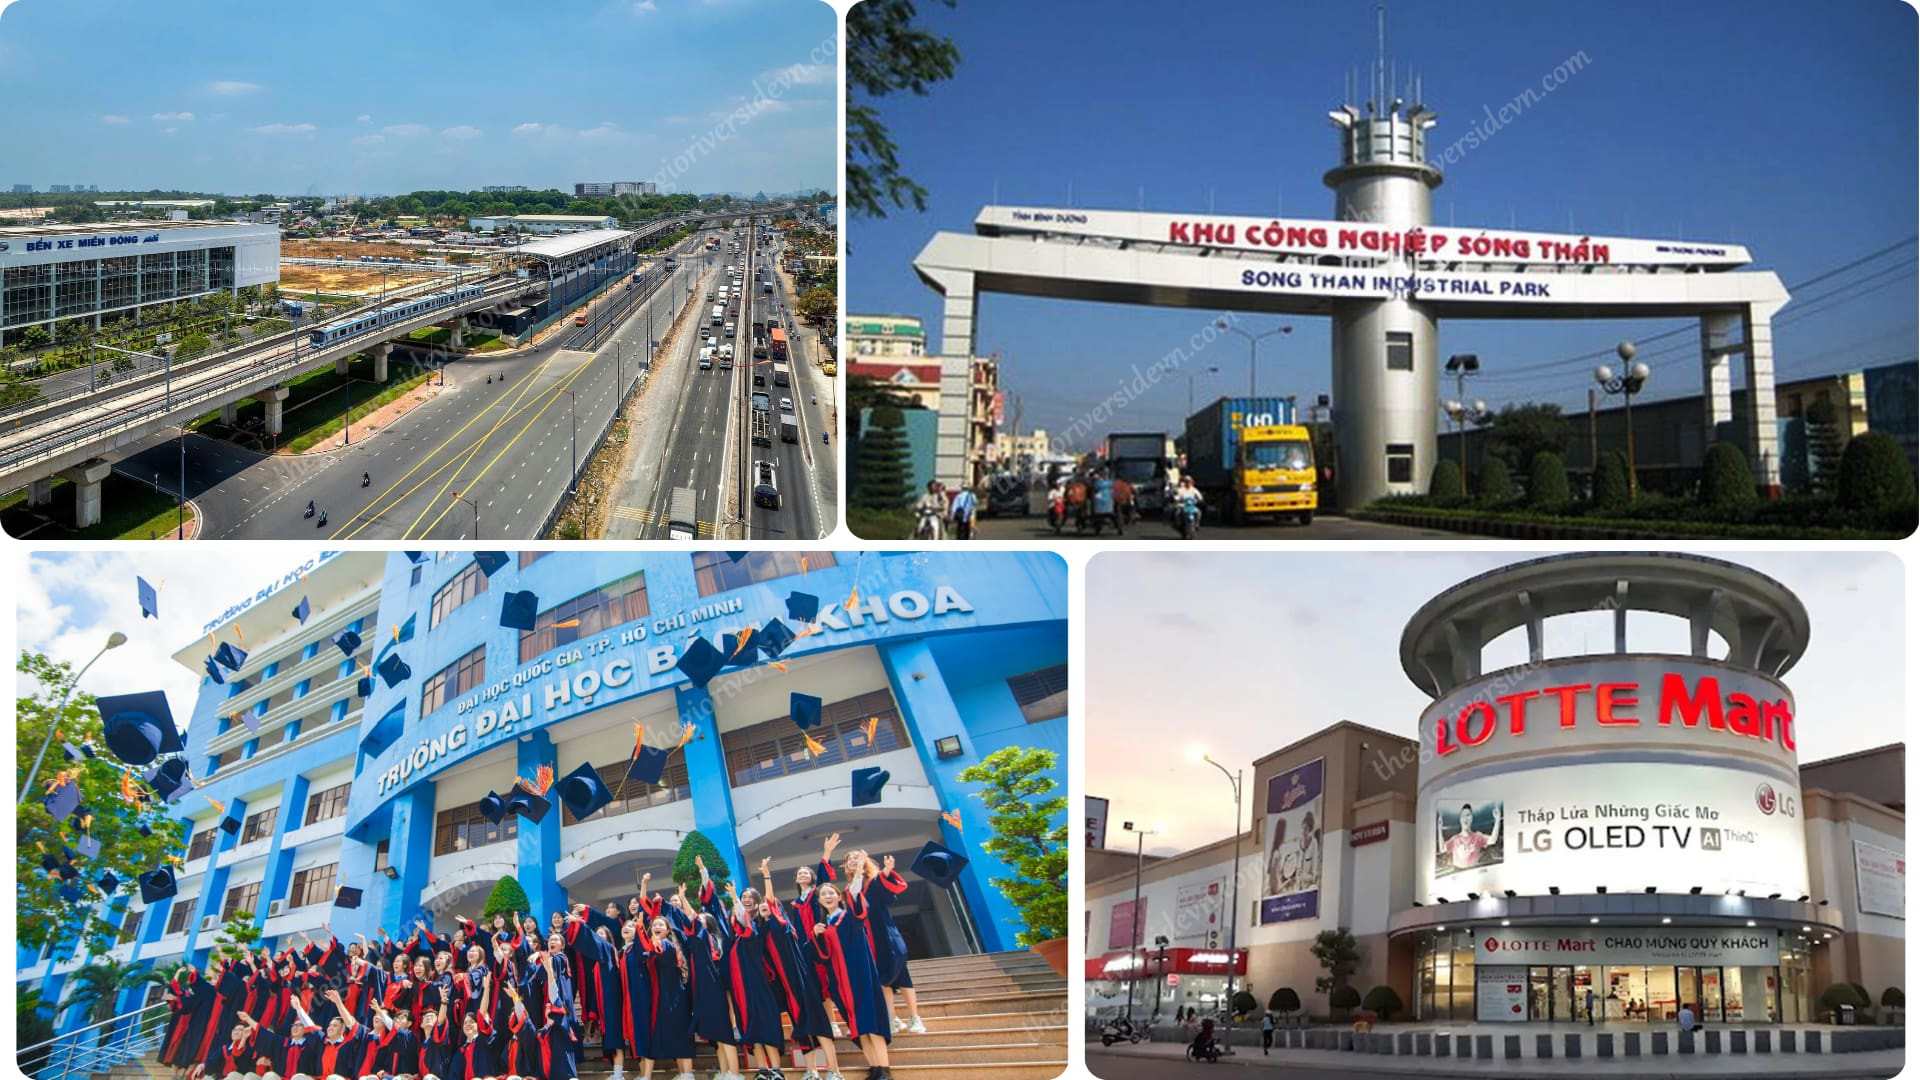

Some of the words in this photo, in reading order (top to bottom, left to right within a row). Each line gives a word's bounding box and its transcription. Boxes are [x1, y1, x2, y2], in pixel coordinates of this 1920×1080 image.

[26, 237, 52, 252] BẾN
[57, 239, 74, 250] XE
[109, 234, 139, 246] ĐÔNG
[1169, 220, 1235, 246] KHU
[1245, 220, 1328, 248] CÔNG
[1338, 227, 1448, 258] NGHIỆP
[1457, 231, 1531, 259] SÓNG
[1241, 269, 1302, 288] SONG
[1309, 272, 1366, 291] THAN
[1372, 276, 1494, 295] INDUSTRIAL
[1499, 280, 1551, 298] PARK
[457, 693, 480, 716] ĐẠI
[482, 679, 511, 703] HỌC
[512, 658, 553, 687] QUỐC
[556, 649, 584, 669] GIA
[587, 635, 616, 657] TP.
[621, 620, 648, 646] HỒ
[652, 608, 687, 636] CHÍ
[690, 596, 744, 625] MINH
[377, 723, 468, 797] TRƯỜNG
[476, 692, 533, 740] ĐẠI
[544, 658, 633, 710] HỌC
[810, 584, 976, 636] KHOA
[1435, 682, 1641, 757] LOTTE
[1657, 672, 1796, 752] Mart
[1518, 807, 1555, 824] Tháp
[1595, 803, 1649, 821] Những
[1655, 803, 1691, 819] Giấc
[1778, 792, 1796, 819] LG
[1517, 828, 1553, 853] LG
[1564, 825, 1646, 851] OLED
[1652, 825, 1692, 849] TV
[1701, 829, 1721, 850] AI
[1501, 939, 1552, 953] LOTTE
[1556, 938, 1597, 953] Mart
[1690, 935, 1719, 951] QUÝ
[1721, 935, 1770, 950] KHÁCH
